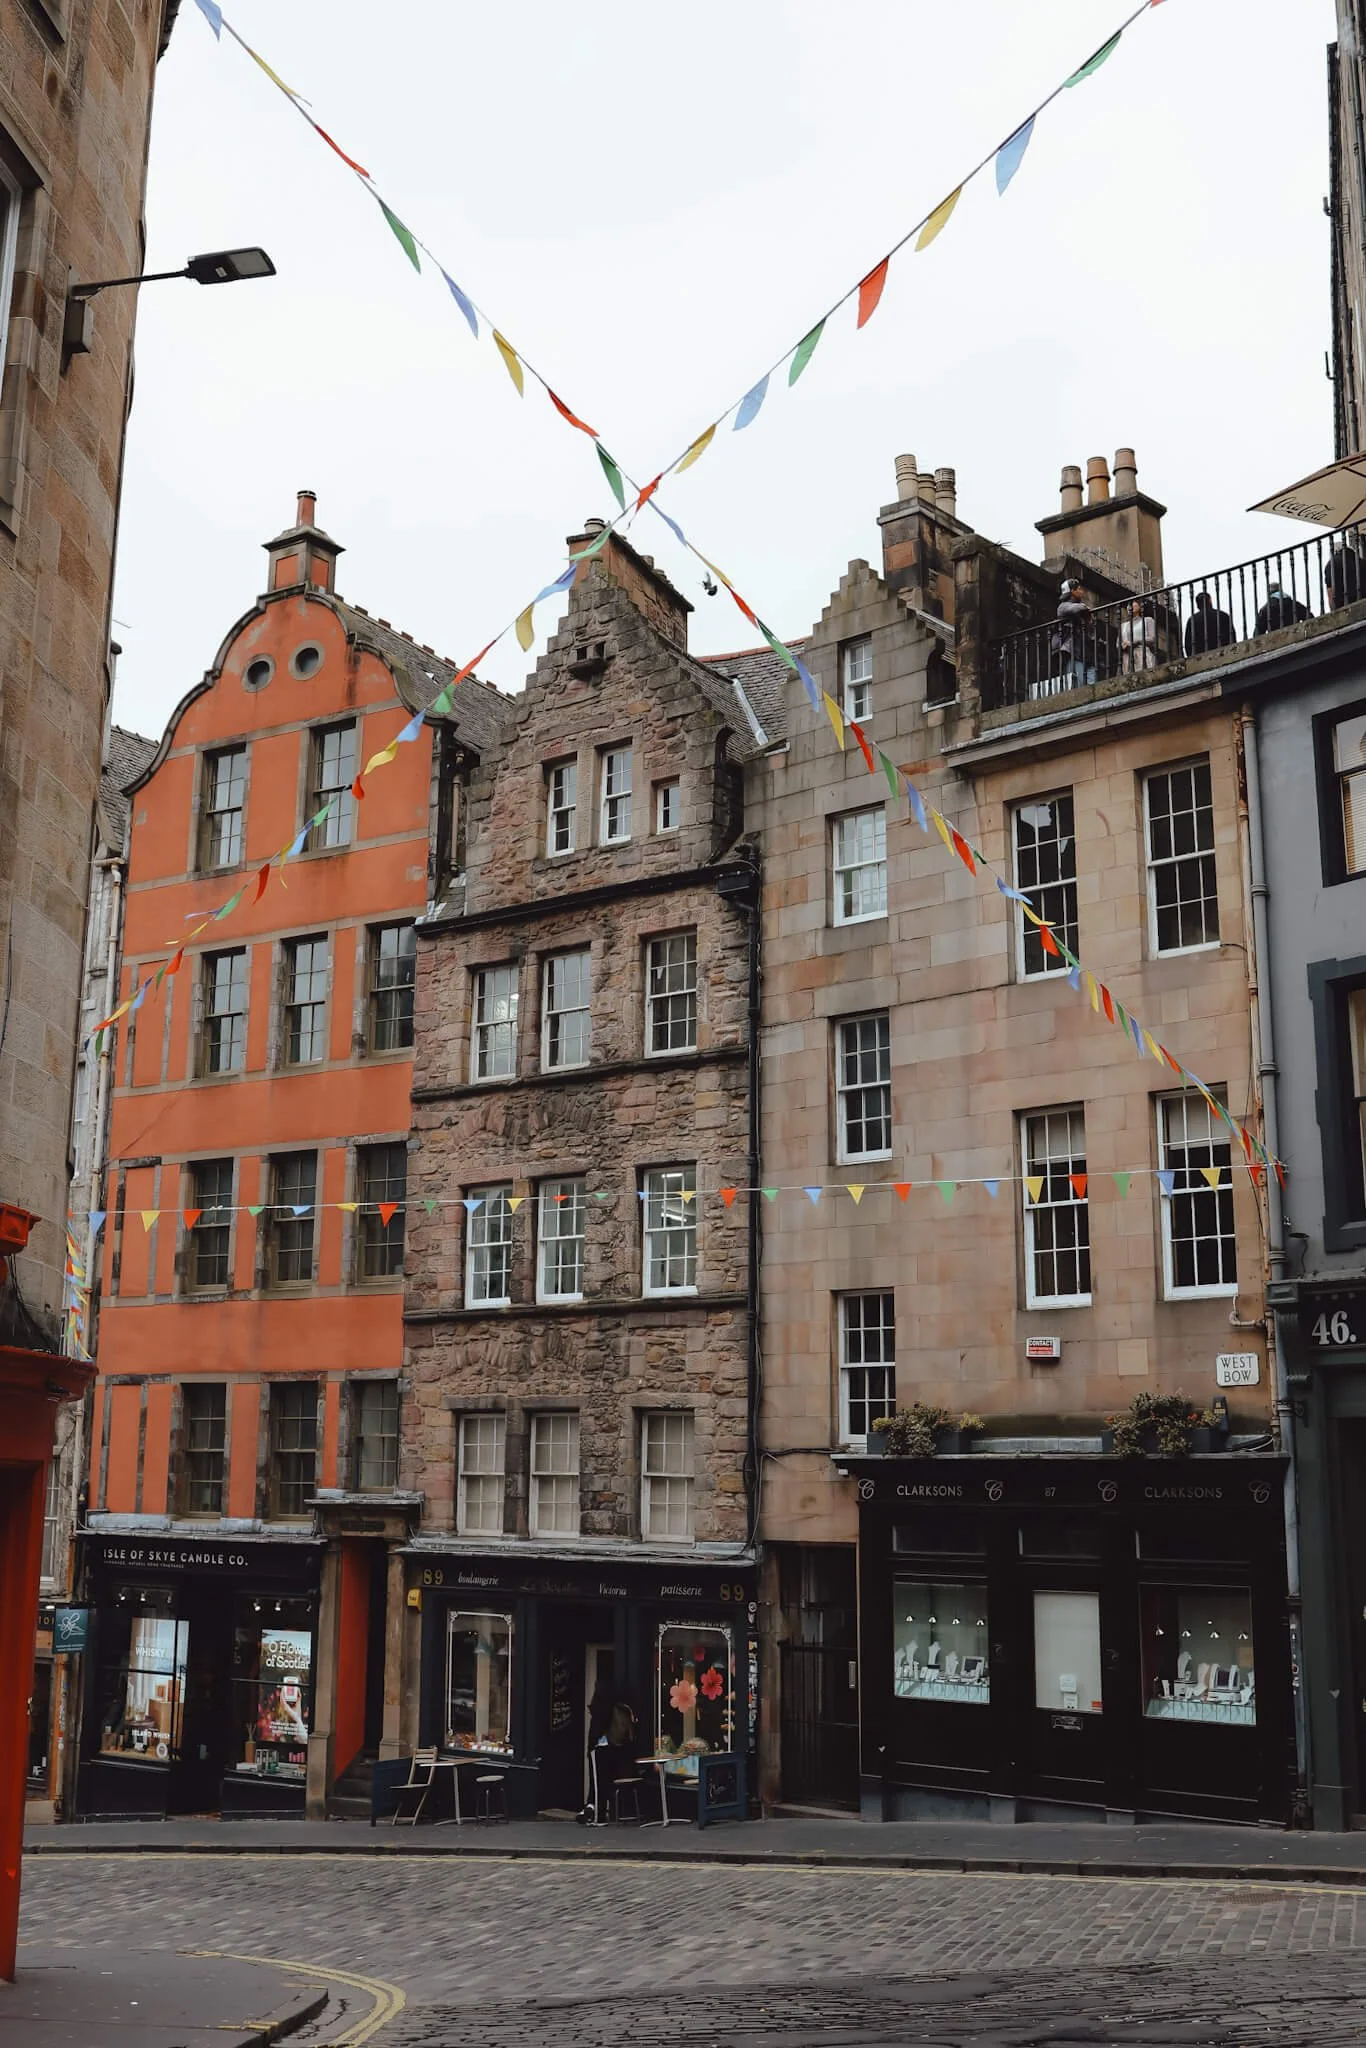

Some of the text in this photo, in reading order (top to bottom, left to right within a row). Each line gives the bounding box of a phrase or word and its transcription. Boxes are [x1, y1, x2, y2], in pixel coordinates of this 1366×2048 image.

[1311, 1310, 1357, 1345] 46.
[1220, 1356, 1254, 1368] WEST
[1224, 1370, 1251, 1383] BOW
[896, 1485, 963, 1496] CLARKSONS
[1044, 1486, 1056, 1497] 87
[1144, 1486, 1223, 1498] CLARKSONS
[103, 1549, 249, 1567] ISLE OF SKYE CANDLE CO.
[423, 1568, 499, 1586] 89 boulangerie
[598, 1583, 627, 1596] Victoria
[660, 1583, 745, 1601] patisserie 89
[135, 1647, 165, 1658] WHISKY
[265, 1654, 276, 1667] of
